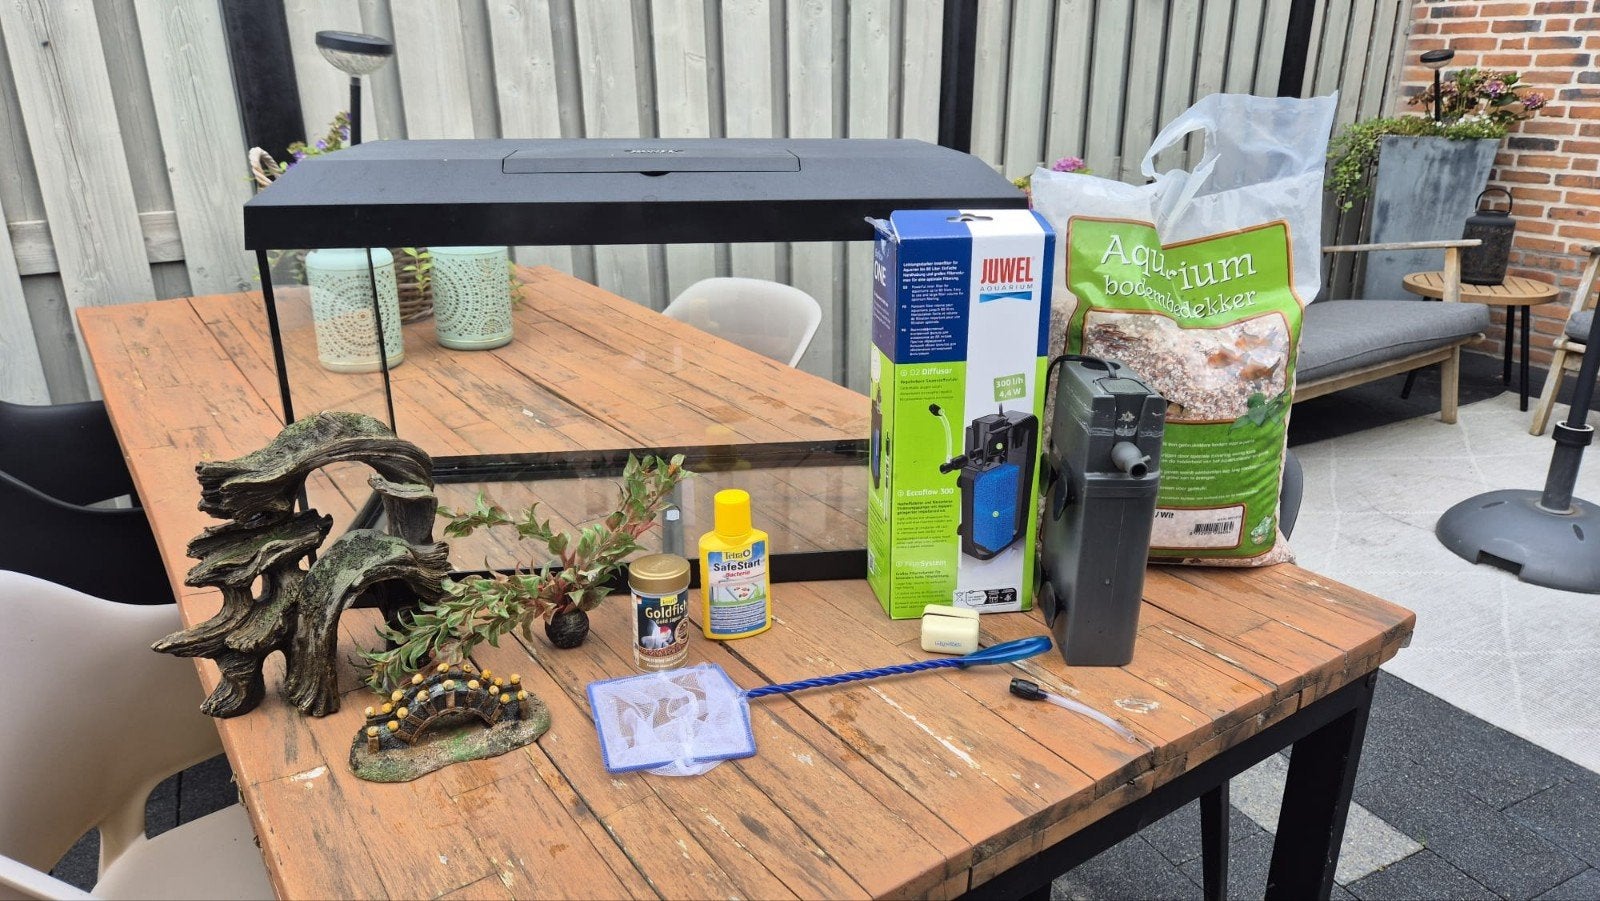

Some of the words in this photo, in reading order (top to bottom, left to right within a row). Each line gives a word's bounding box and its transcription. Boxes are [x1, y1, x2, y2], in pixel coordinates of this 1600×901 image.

[1101, 234, 1257, 291] Aqurium
[981, 256, 1034, 284] JUWEL
[1104, 275, 1257, 319] bodembedekker
[922, 367, 952, 375] Diffusor
[995, 379, 1011, 388] 300
[1012, 377, 1024, 386] l/h
[1000, 389, 1012, 398] 4,4
[1013, 387, 1022, 396] W
[725, 550, 743, 559] Tetra
[713, 559, 761, 572] SafeStart
[725, 570, 751, 578] Bacteria
